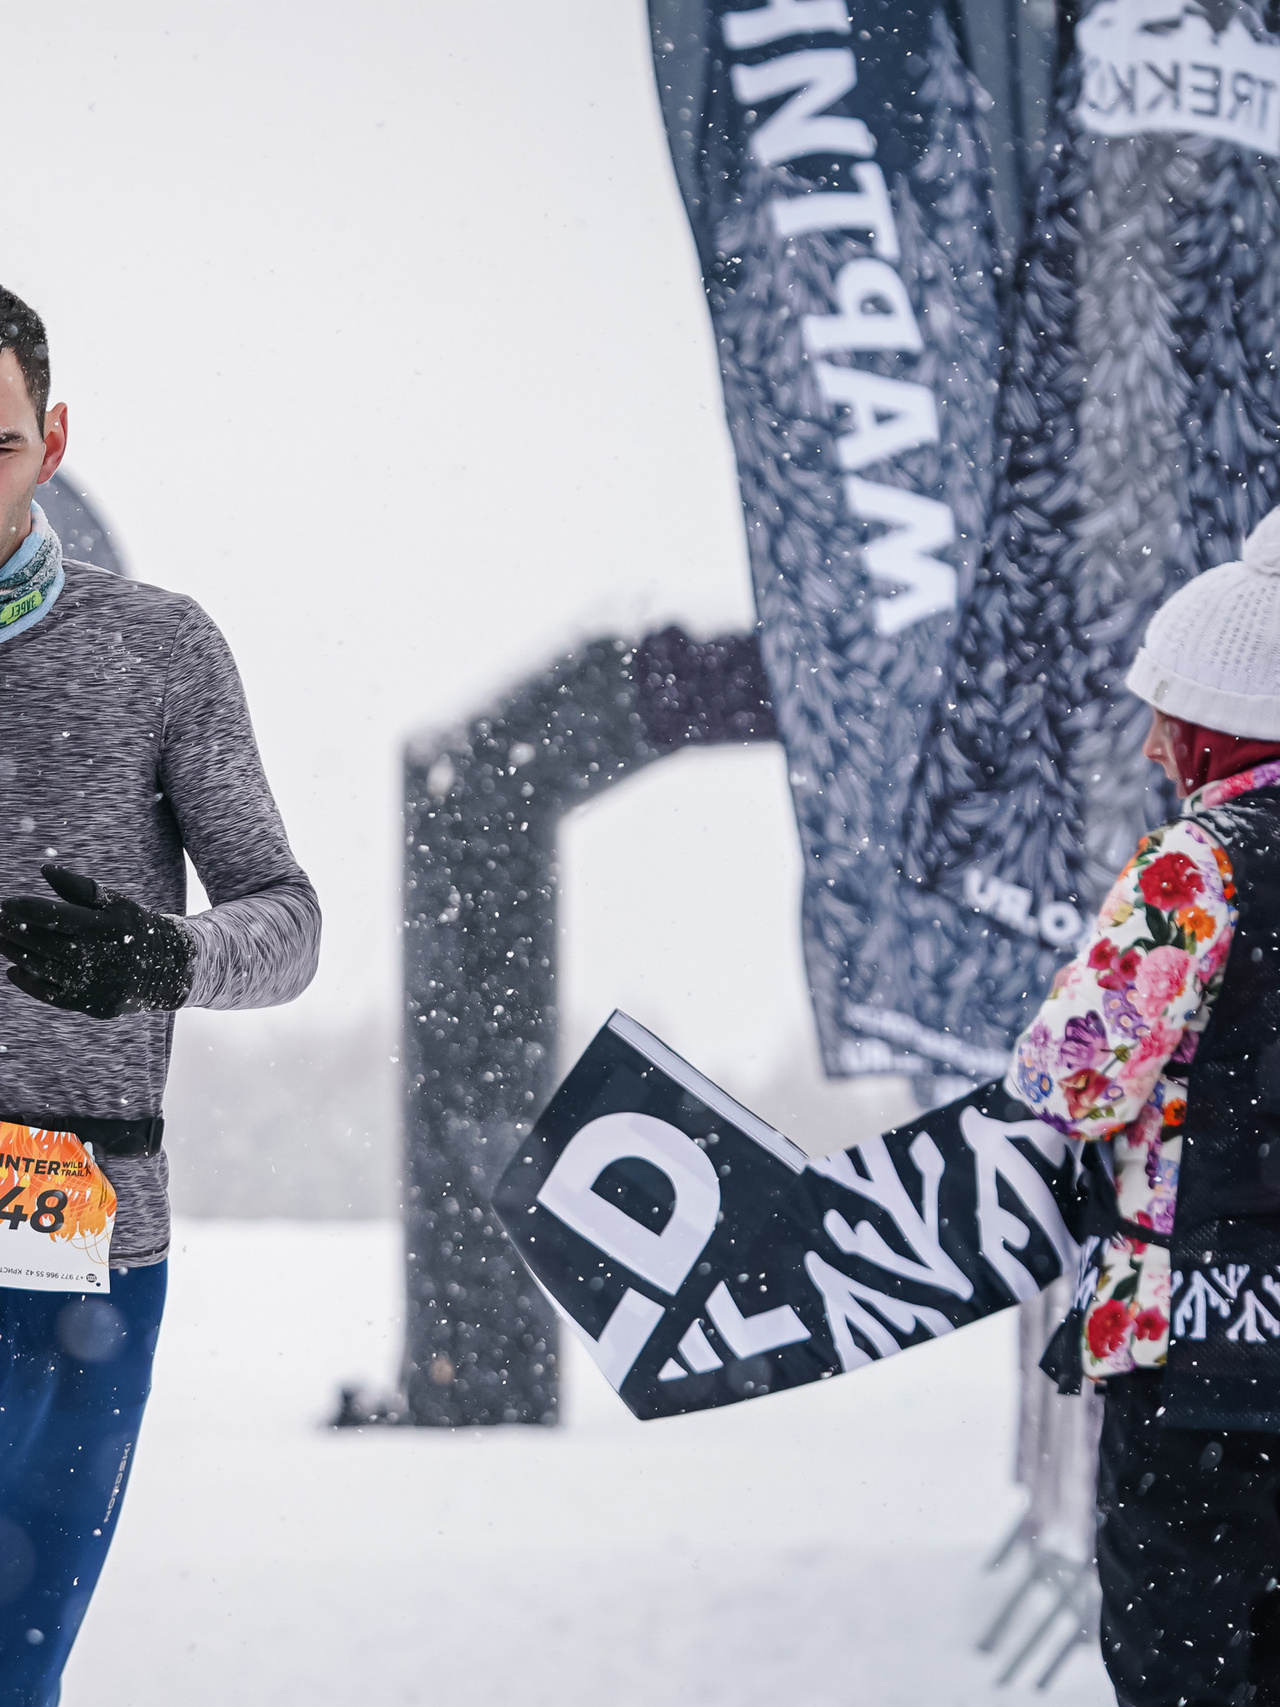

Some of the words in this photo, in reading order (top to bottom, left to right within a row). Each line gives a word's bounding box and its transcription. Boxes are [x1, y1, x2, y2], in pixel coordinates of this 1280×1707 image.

[62, 1161, 83, 1169] WILD
[60, 1168, 84, 1177] TRAIL
[45, 1271, 59, 1279] 966
